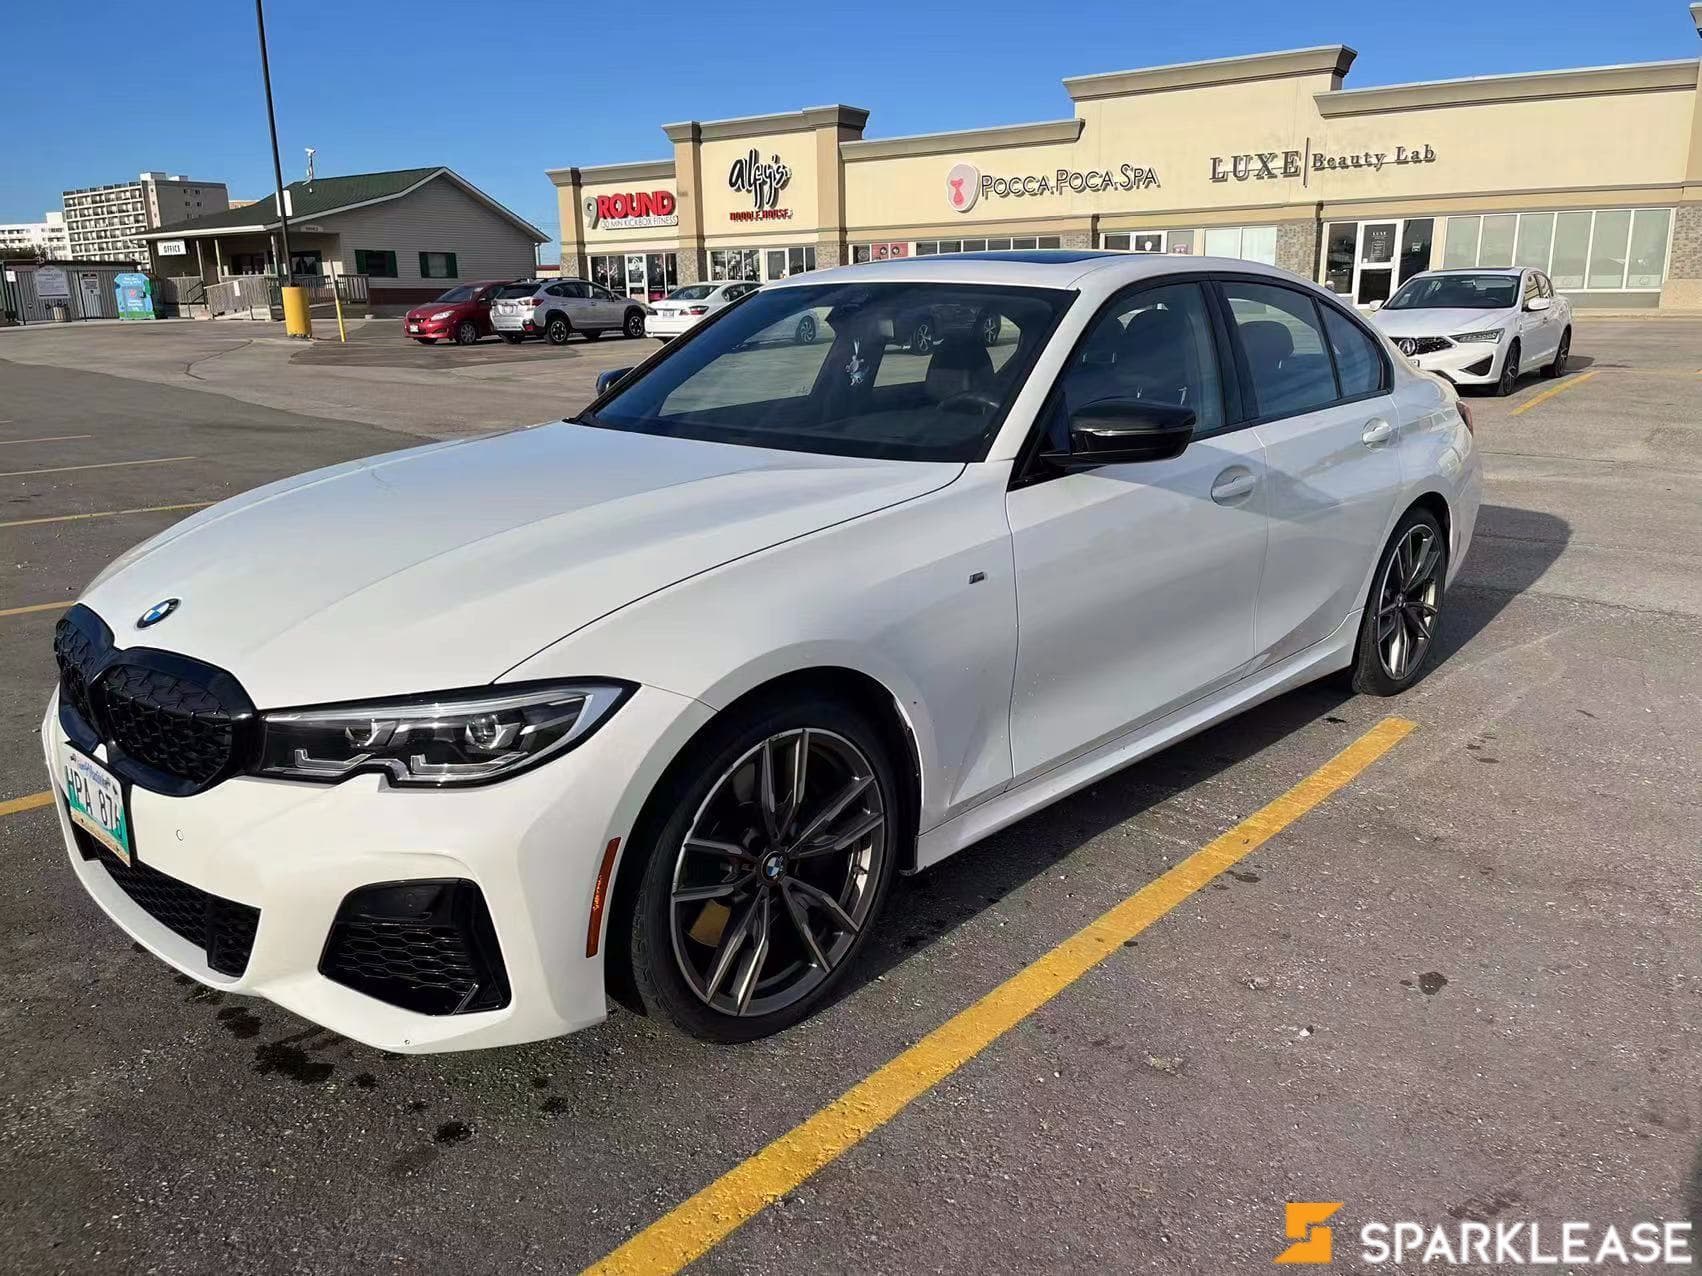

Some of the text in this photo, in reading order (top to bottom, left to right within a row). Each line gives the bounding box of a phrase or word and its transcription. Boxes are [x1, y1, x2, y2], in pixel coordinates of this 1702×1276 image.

[980, 163, 1160, 198] POCCA POCA SPA
[1209, 144, 1437, 182] LUXE Beauty Lab
